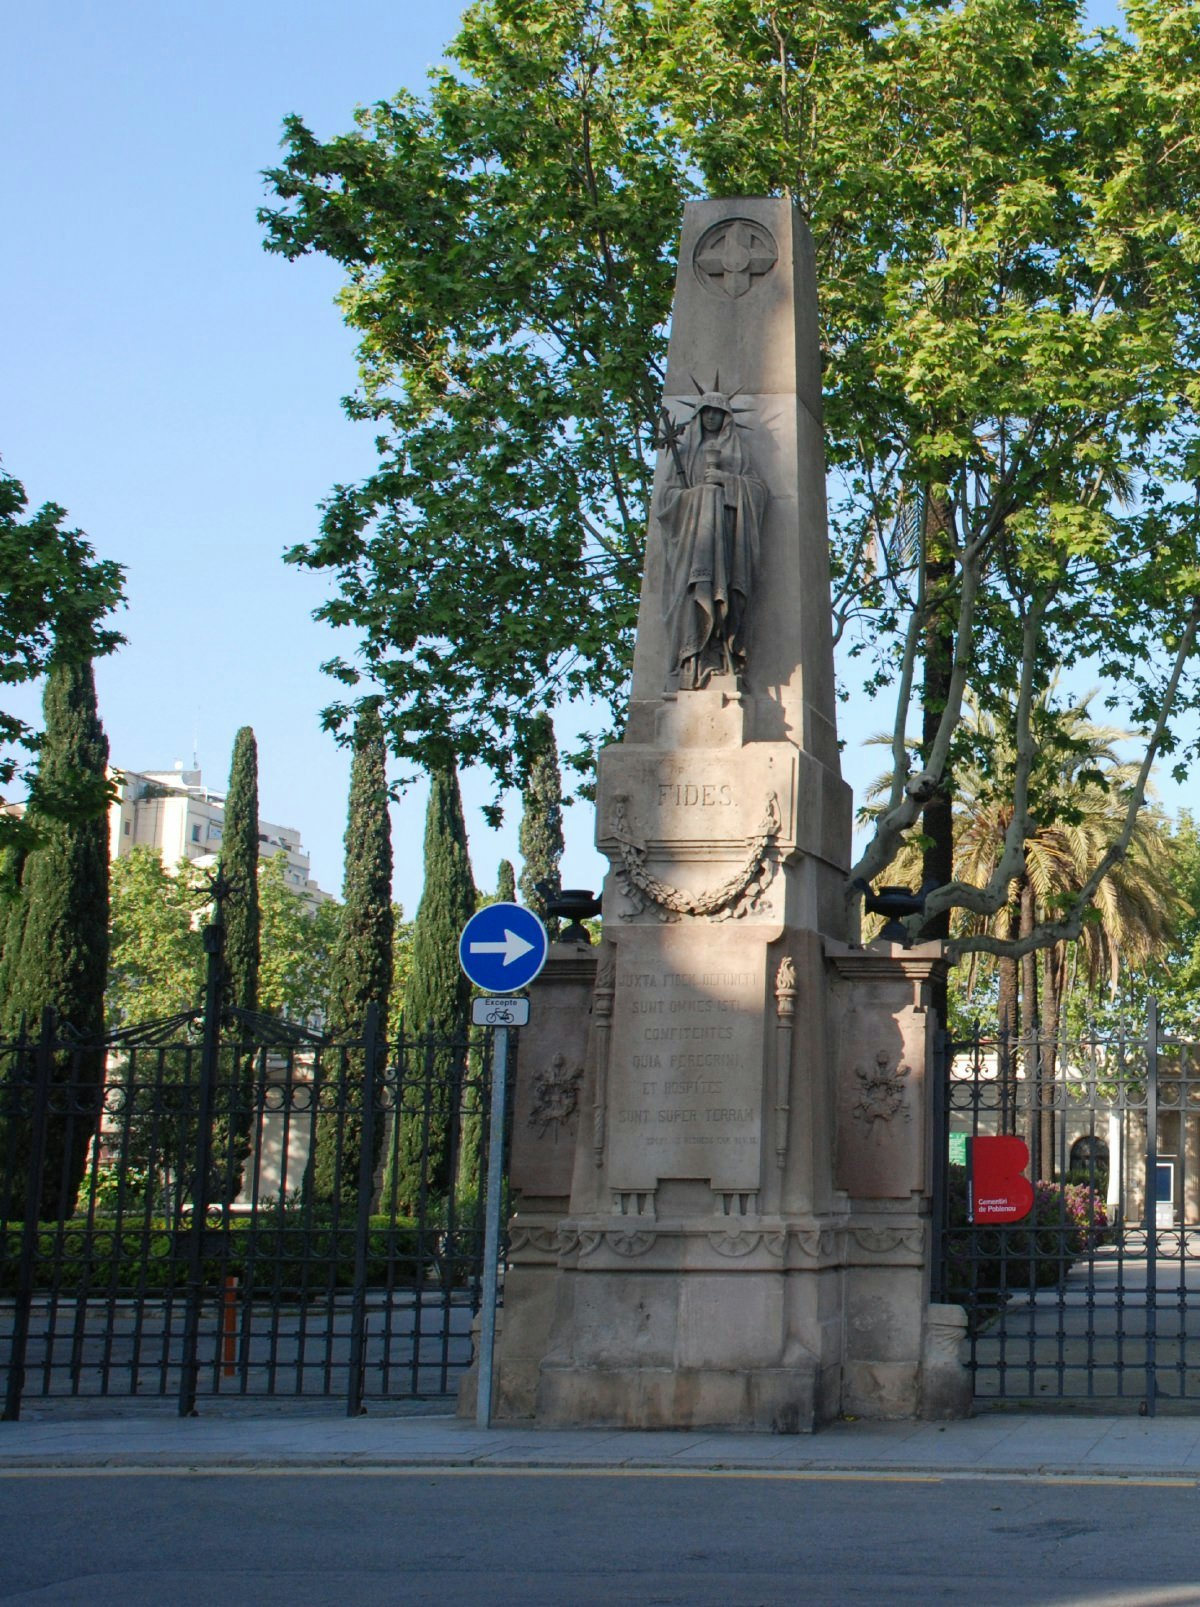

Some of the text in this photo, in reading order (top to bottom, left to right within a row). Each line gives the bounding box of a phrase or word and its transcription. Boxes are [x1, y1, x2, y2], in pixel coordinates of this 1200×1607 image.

[631, 999, 665, 1014] SUNT
[669, 999, 713, 1013] OMNES
[644, 1026, 734, 1041] CONFITENTES
[632, 1054, 662, 1069] QUIA
[642, 1081, 658, 1095] ET
[618, 1107, 754, 1123] SUNT SUPER TERRAM
